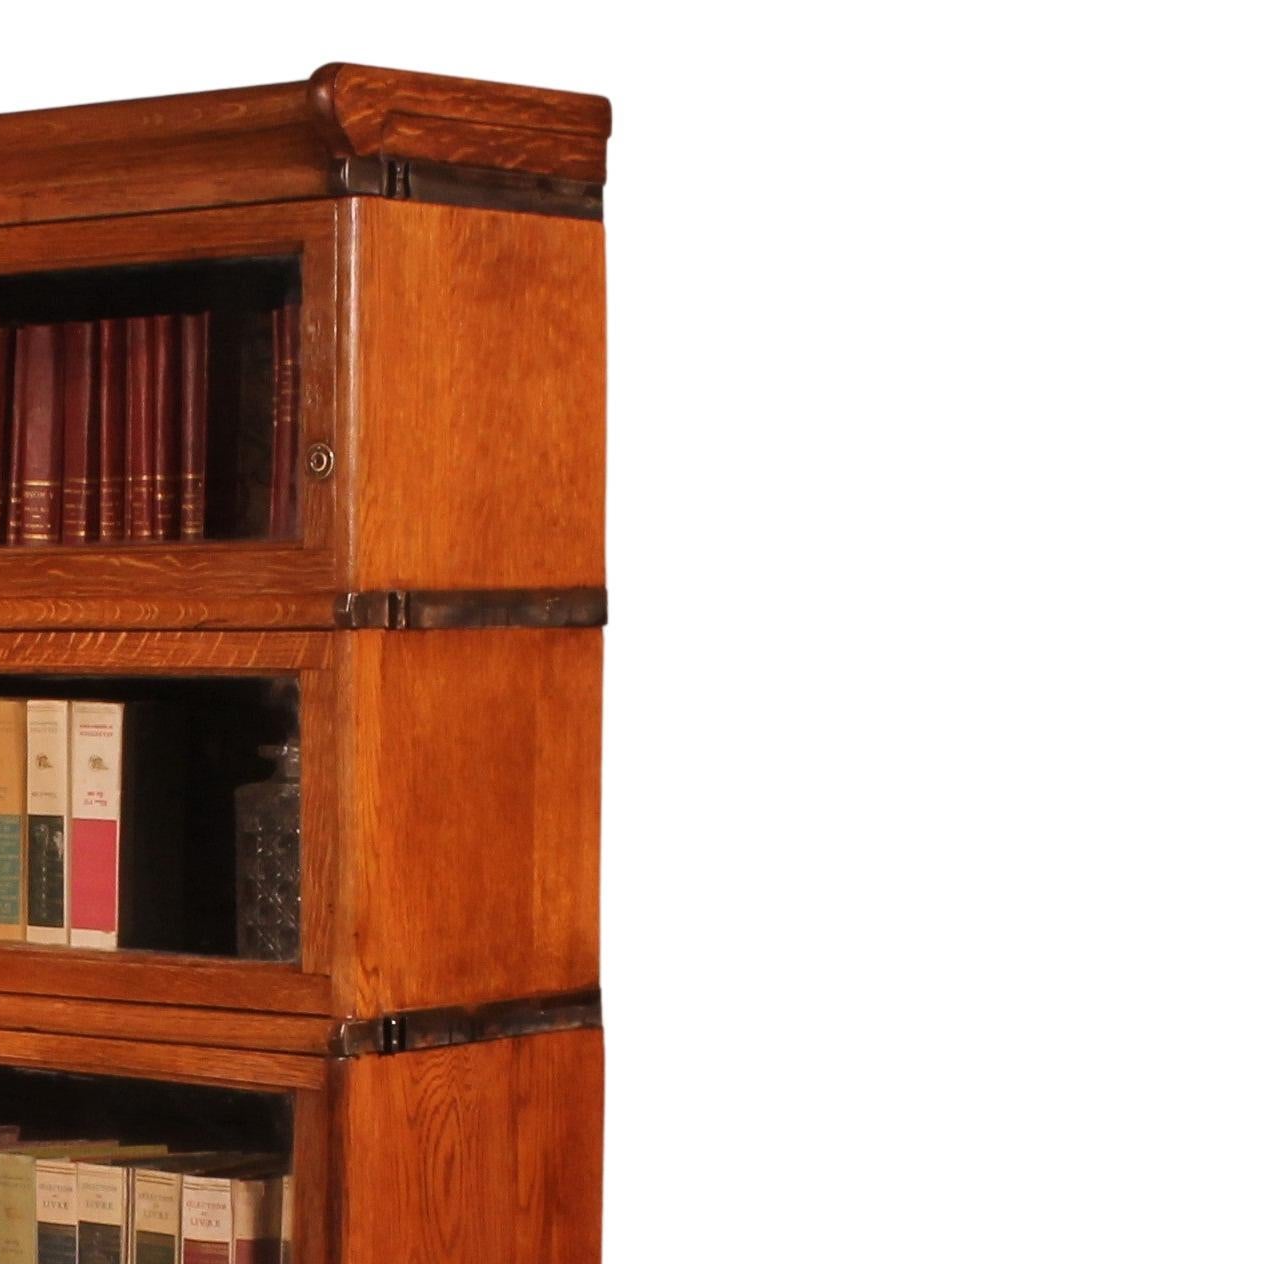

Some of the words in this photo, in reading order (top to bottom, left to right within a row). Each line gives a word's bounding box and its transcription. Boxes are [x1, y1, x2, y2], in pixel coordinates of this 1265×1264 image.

[42, 1200, 69, 1210] LIVRE
[85, 1200, 113, 1210] LIVRE
[190, 1217, 221, 1228] LIVRE
